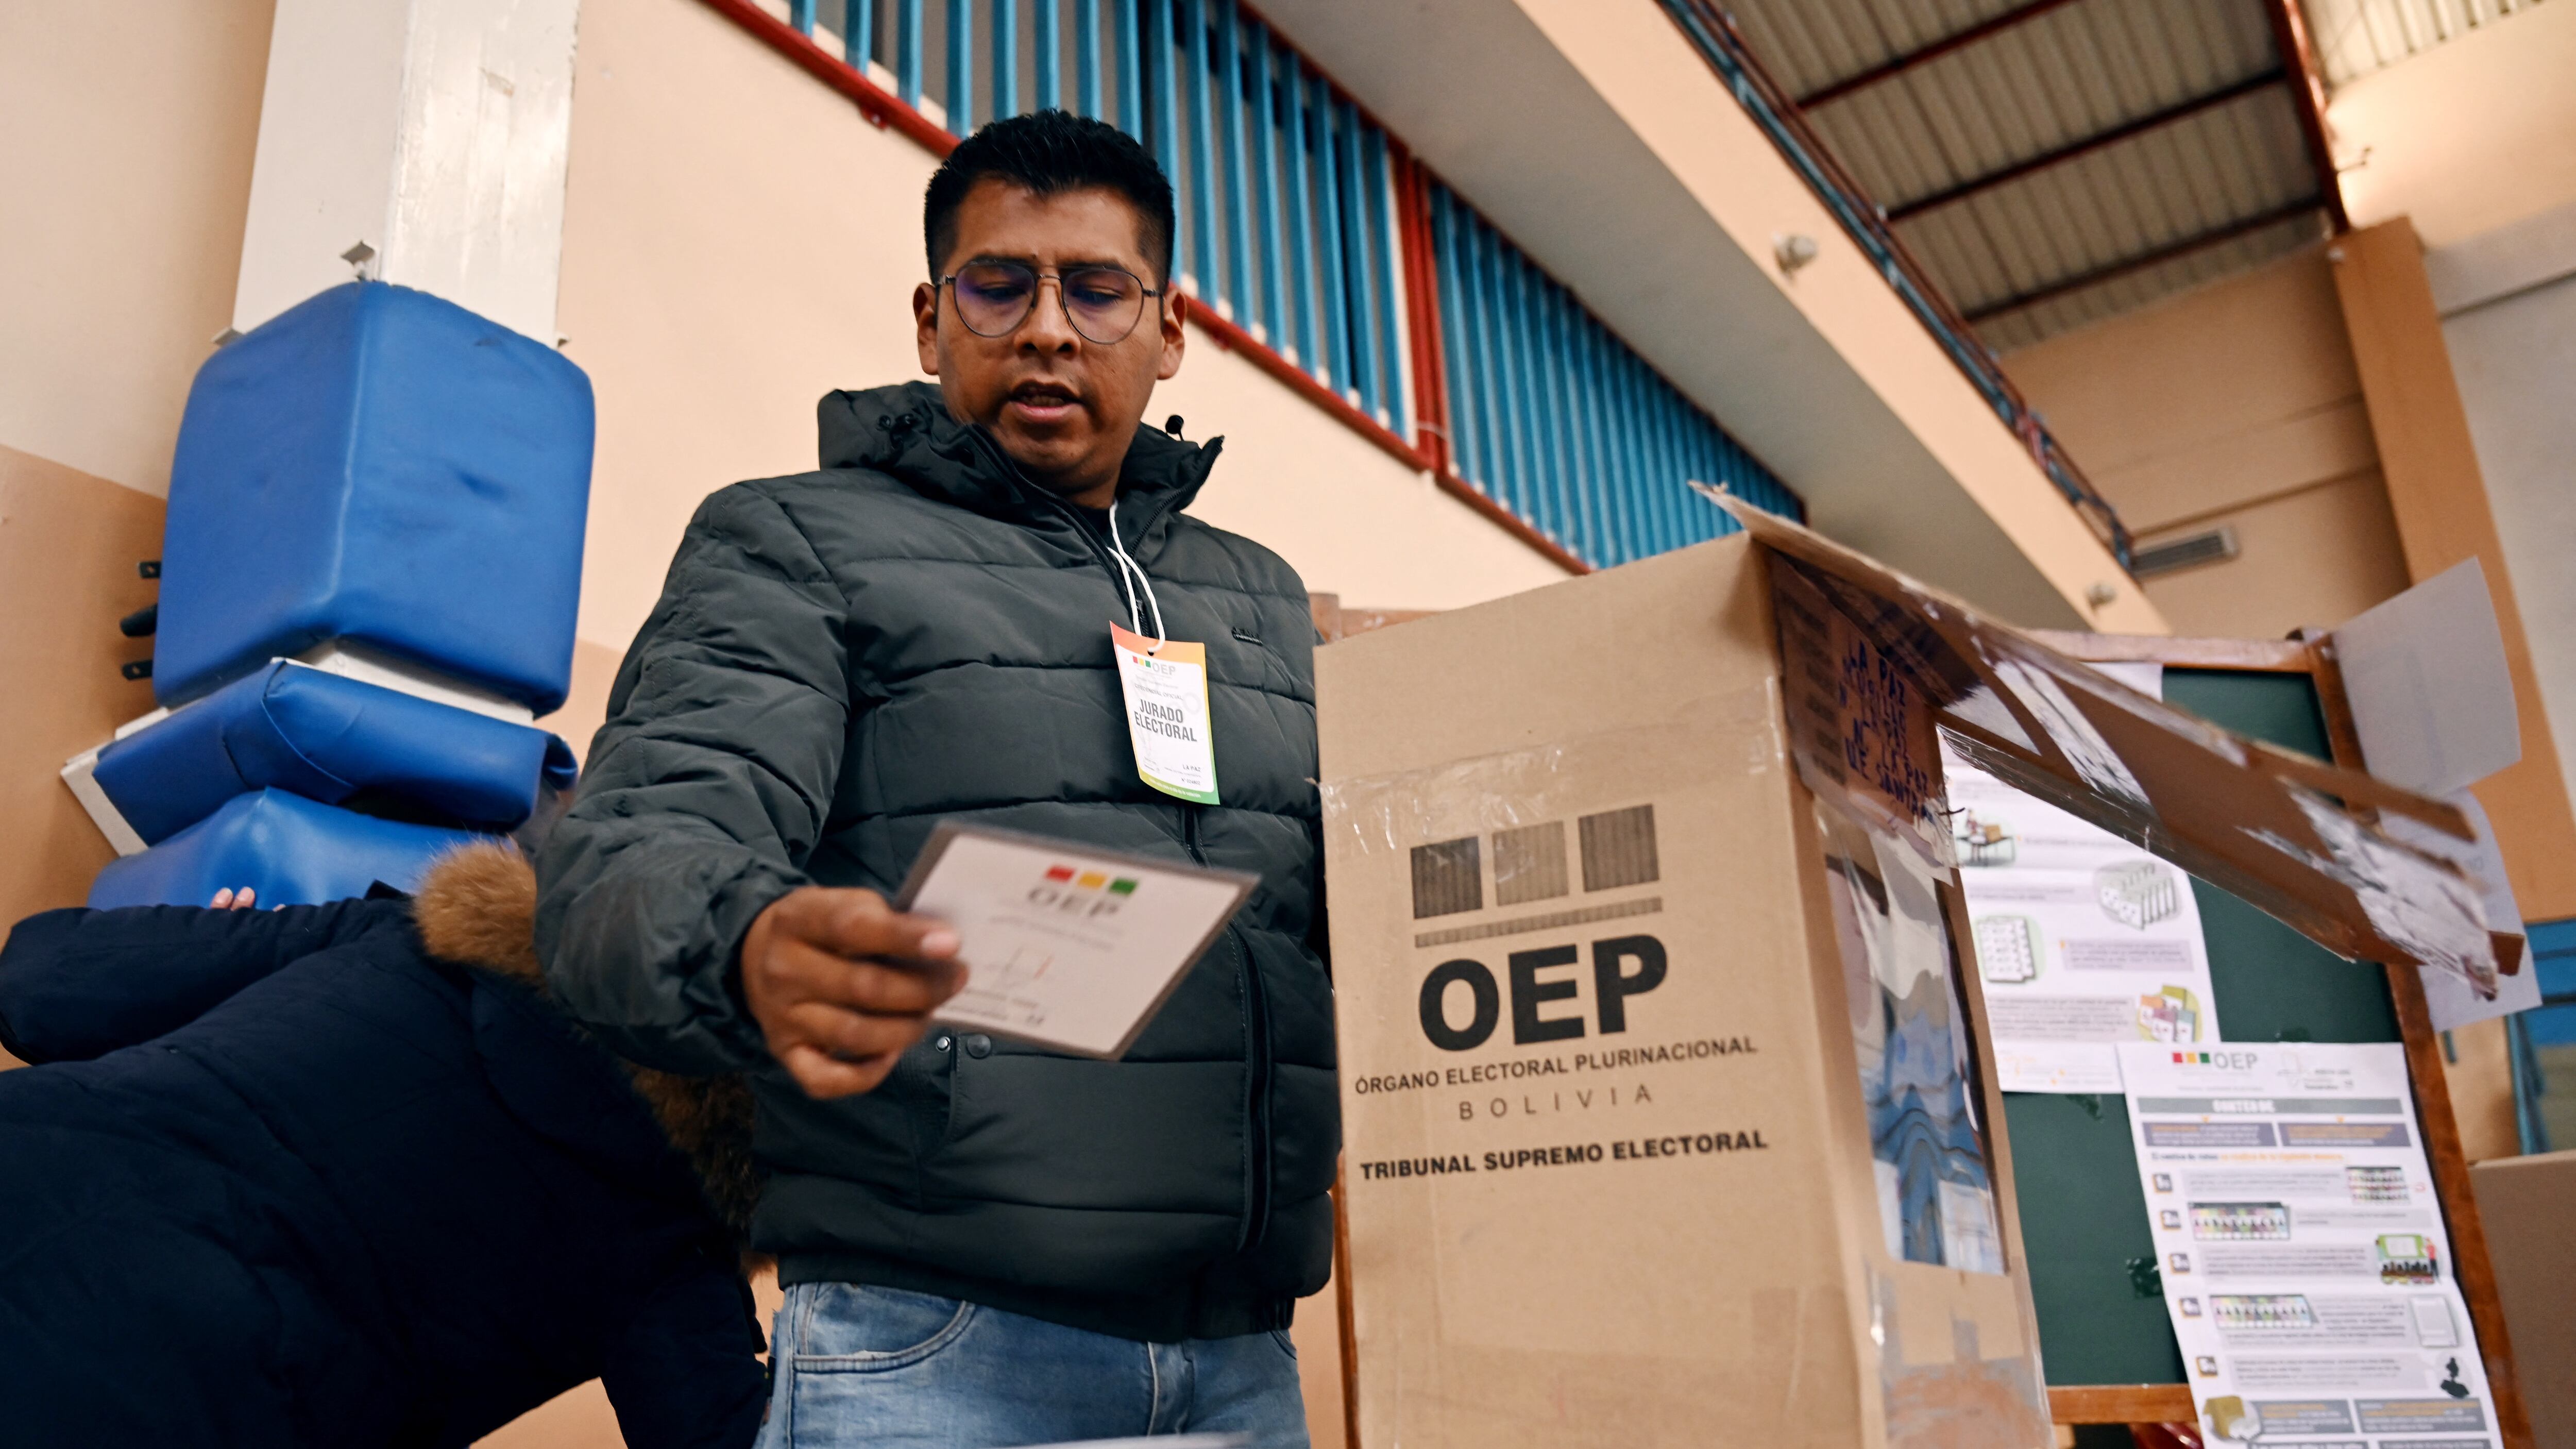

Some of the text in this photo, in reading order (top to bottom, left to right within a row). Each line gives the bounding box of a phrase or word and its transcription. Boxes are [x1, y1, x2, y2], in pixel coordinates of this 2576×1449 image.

[1152, 662, 1176, 676] OEP
[1848, 633, 1906, 707] LA PAZ
[1134, 711, 1197, 742] ELECTORAL
[1139, 698, 1183, 723] JURADO
[1904, 760, 1929, 798] PAZ
[1418, 934, 1668, 1052] OEP
[1355, 1037, 1758, 1095] ÓRGANO ELECTORAL PLURINACIONAL
[2214, 1052, 2258, 1070] OEP
[1459, 1084, 1652, 1121] BOLIVIA
[1360, 1130, 1768, 1180] TRIBUNAL SUPREMO ELECTORAL
